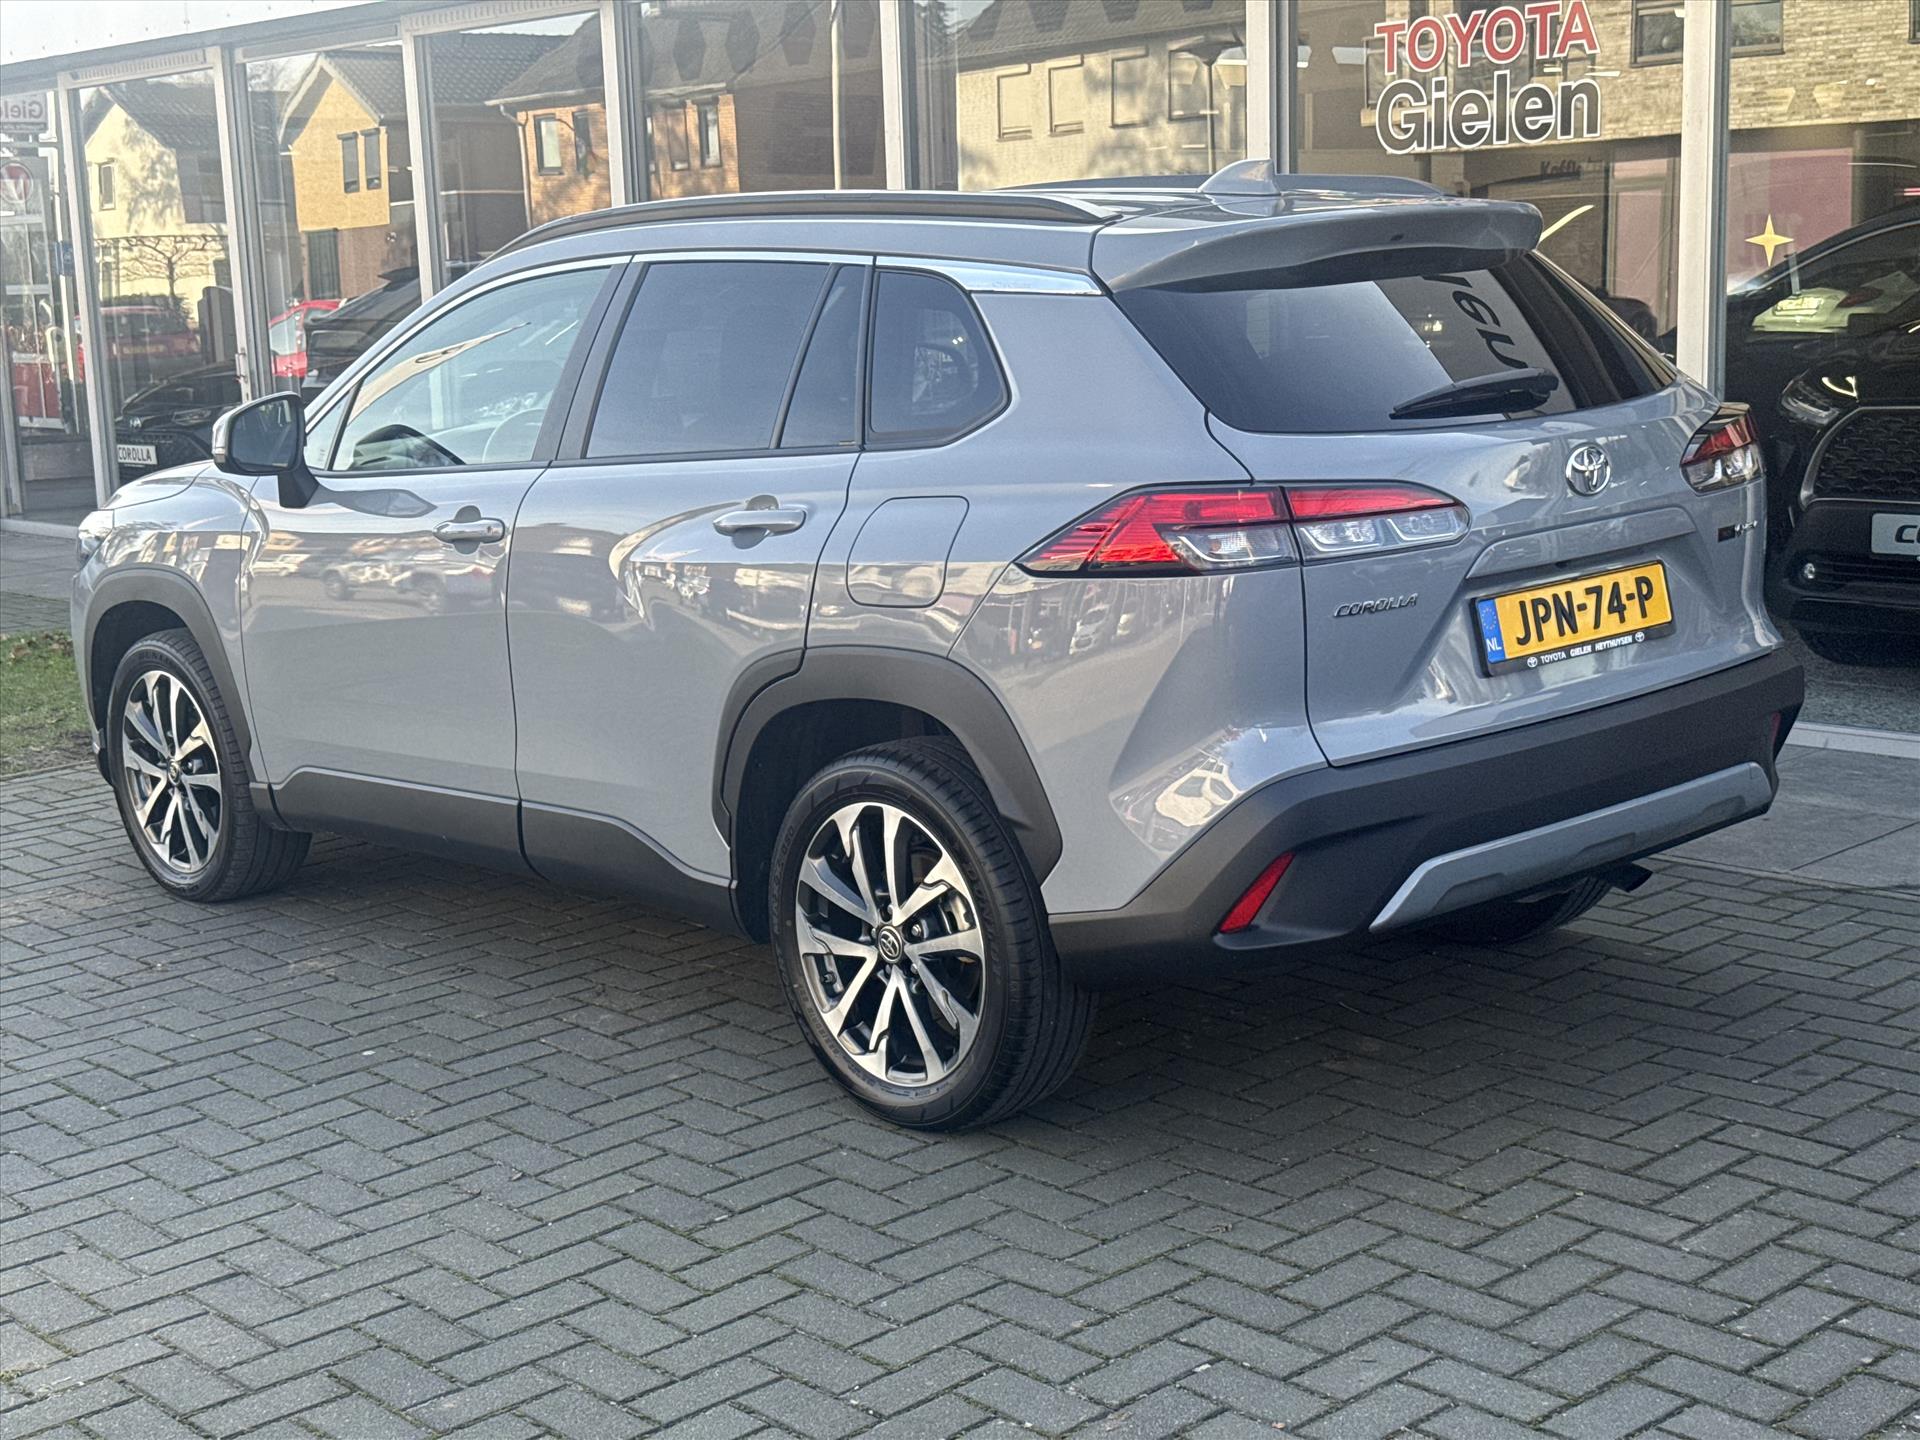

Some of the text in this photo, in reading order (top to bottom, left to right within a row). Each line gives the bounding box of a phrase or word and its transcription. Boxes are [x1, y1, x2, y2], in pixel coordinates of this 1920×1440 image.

[1374, 0, 1600, 77] TOYOTA
[1376, 70, 1602, 155] Gielen
[117, 446, 152, 462] COROLLA
[1895, 524, 1920, 544] C
[1333, 592, 1418, 618] COROLLA
[1516, 575, 1654, 646] JPN-74-P
[1485, 637, 1502, 653] NL
[1540, 651, 1567, 664] TOYOTA
